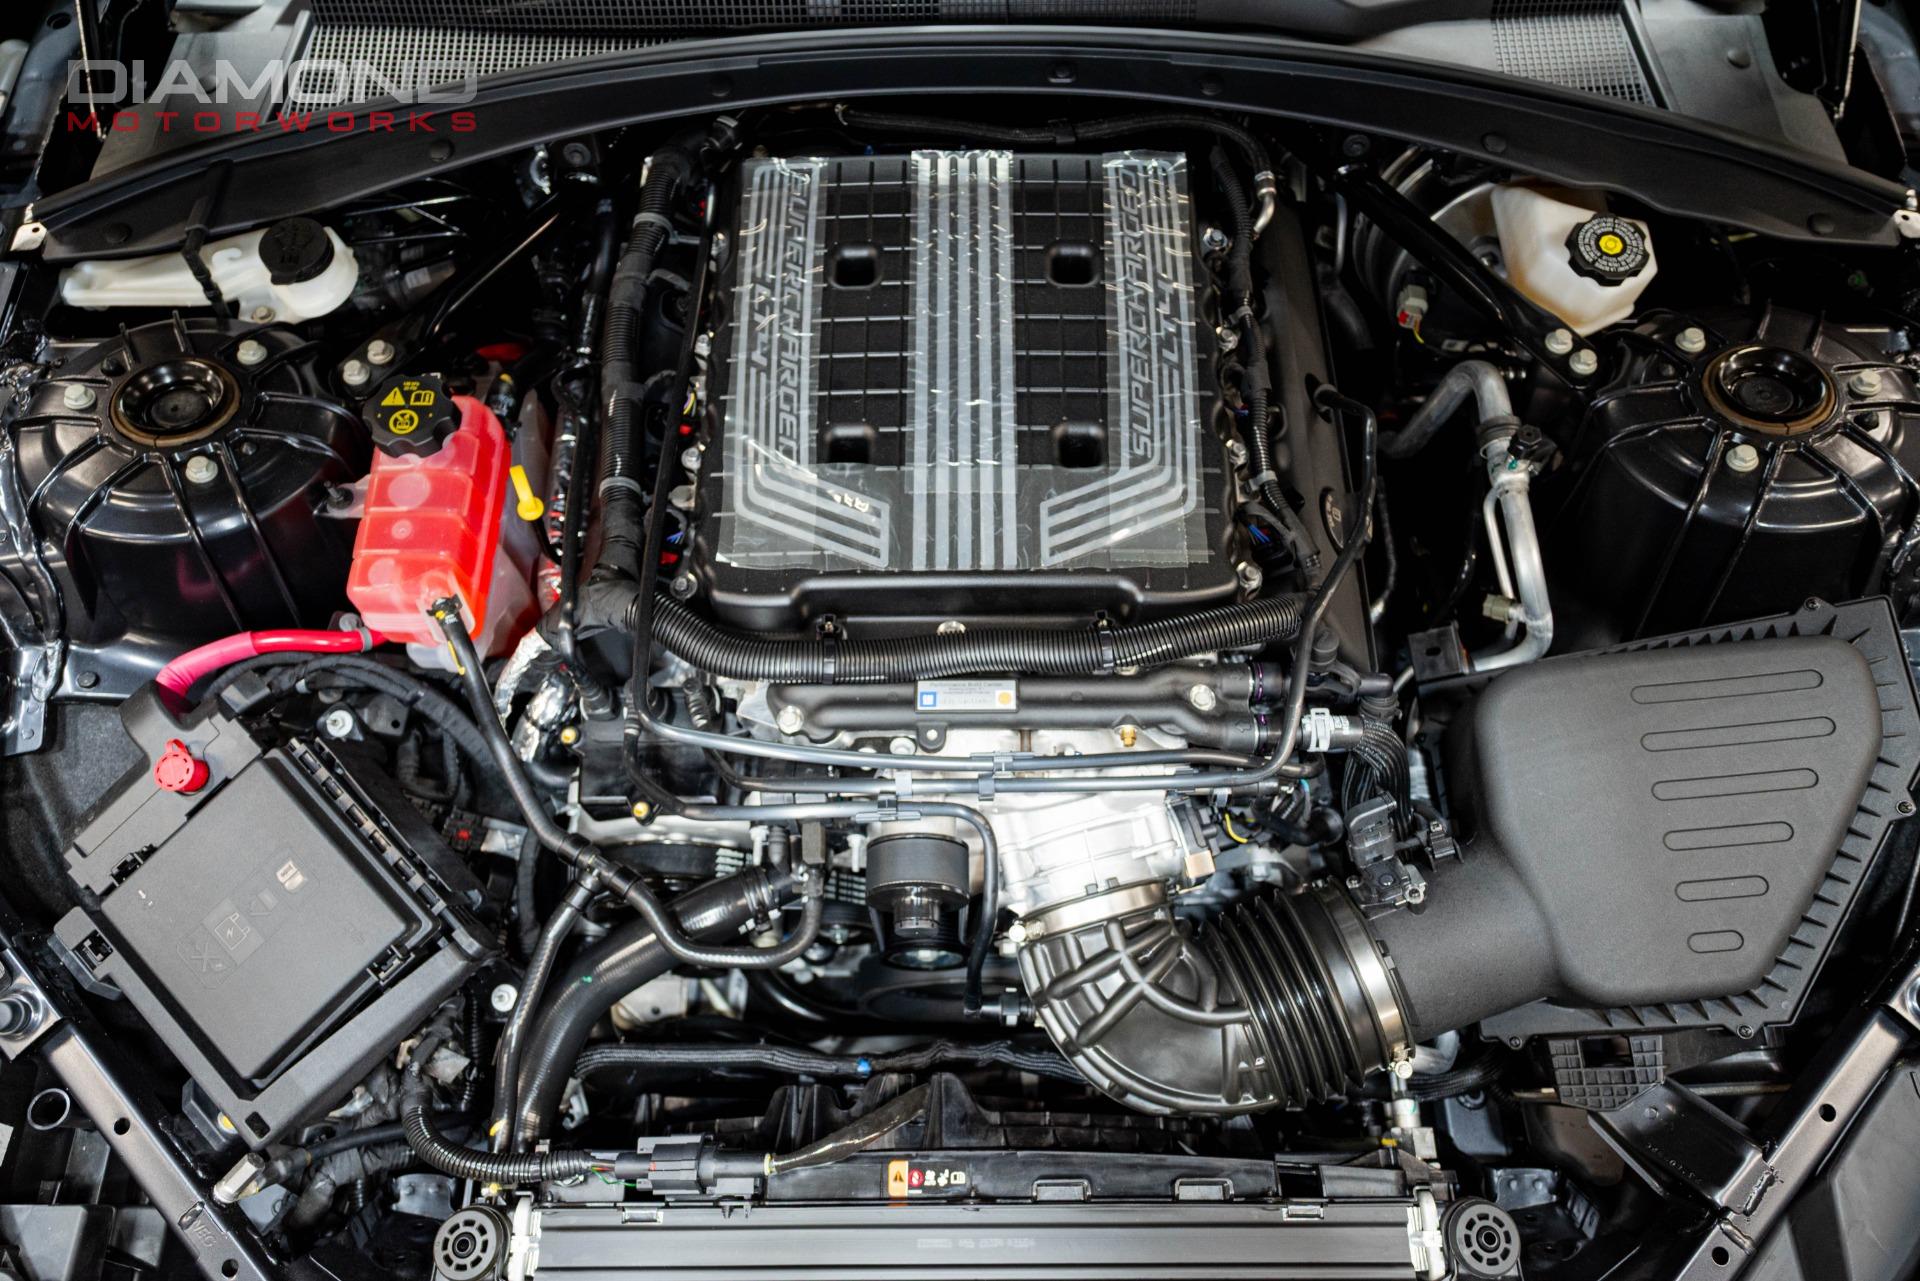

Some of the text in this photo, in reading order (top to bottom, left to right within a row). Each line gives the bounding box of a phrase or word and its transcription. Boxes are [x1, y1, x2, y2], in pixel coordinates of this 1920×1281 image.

[752, 285, 773, 369] LT4
[777, 173, 808, 464] SUPERCHARGED
[1118, 169, 1151, 458] SUPERCHARGED
[1157, 278, 1180, 372] LT4
